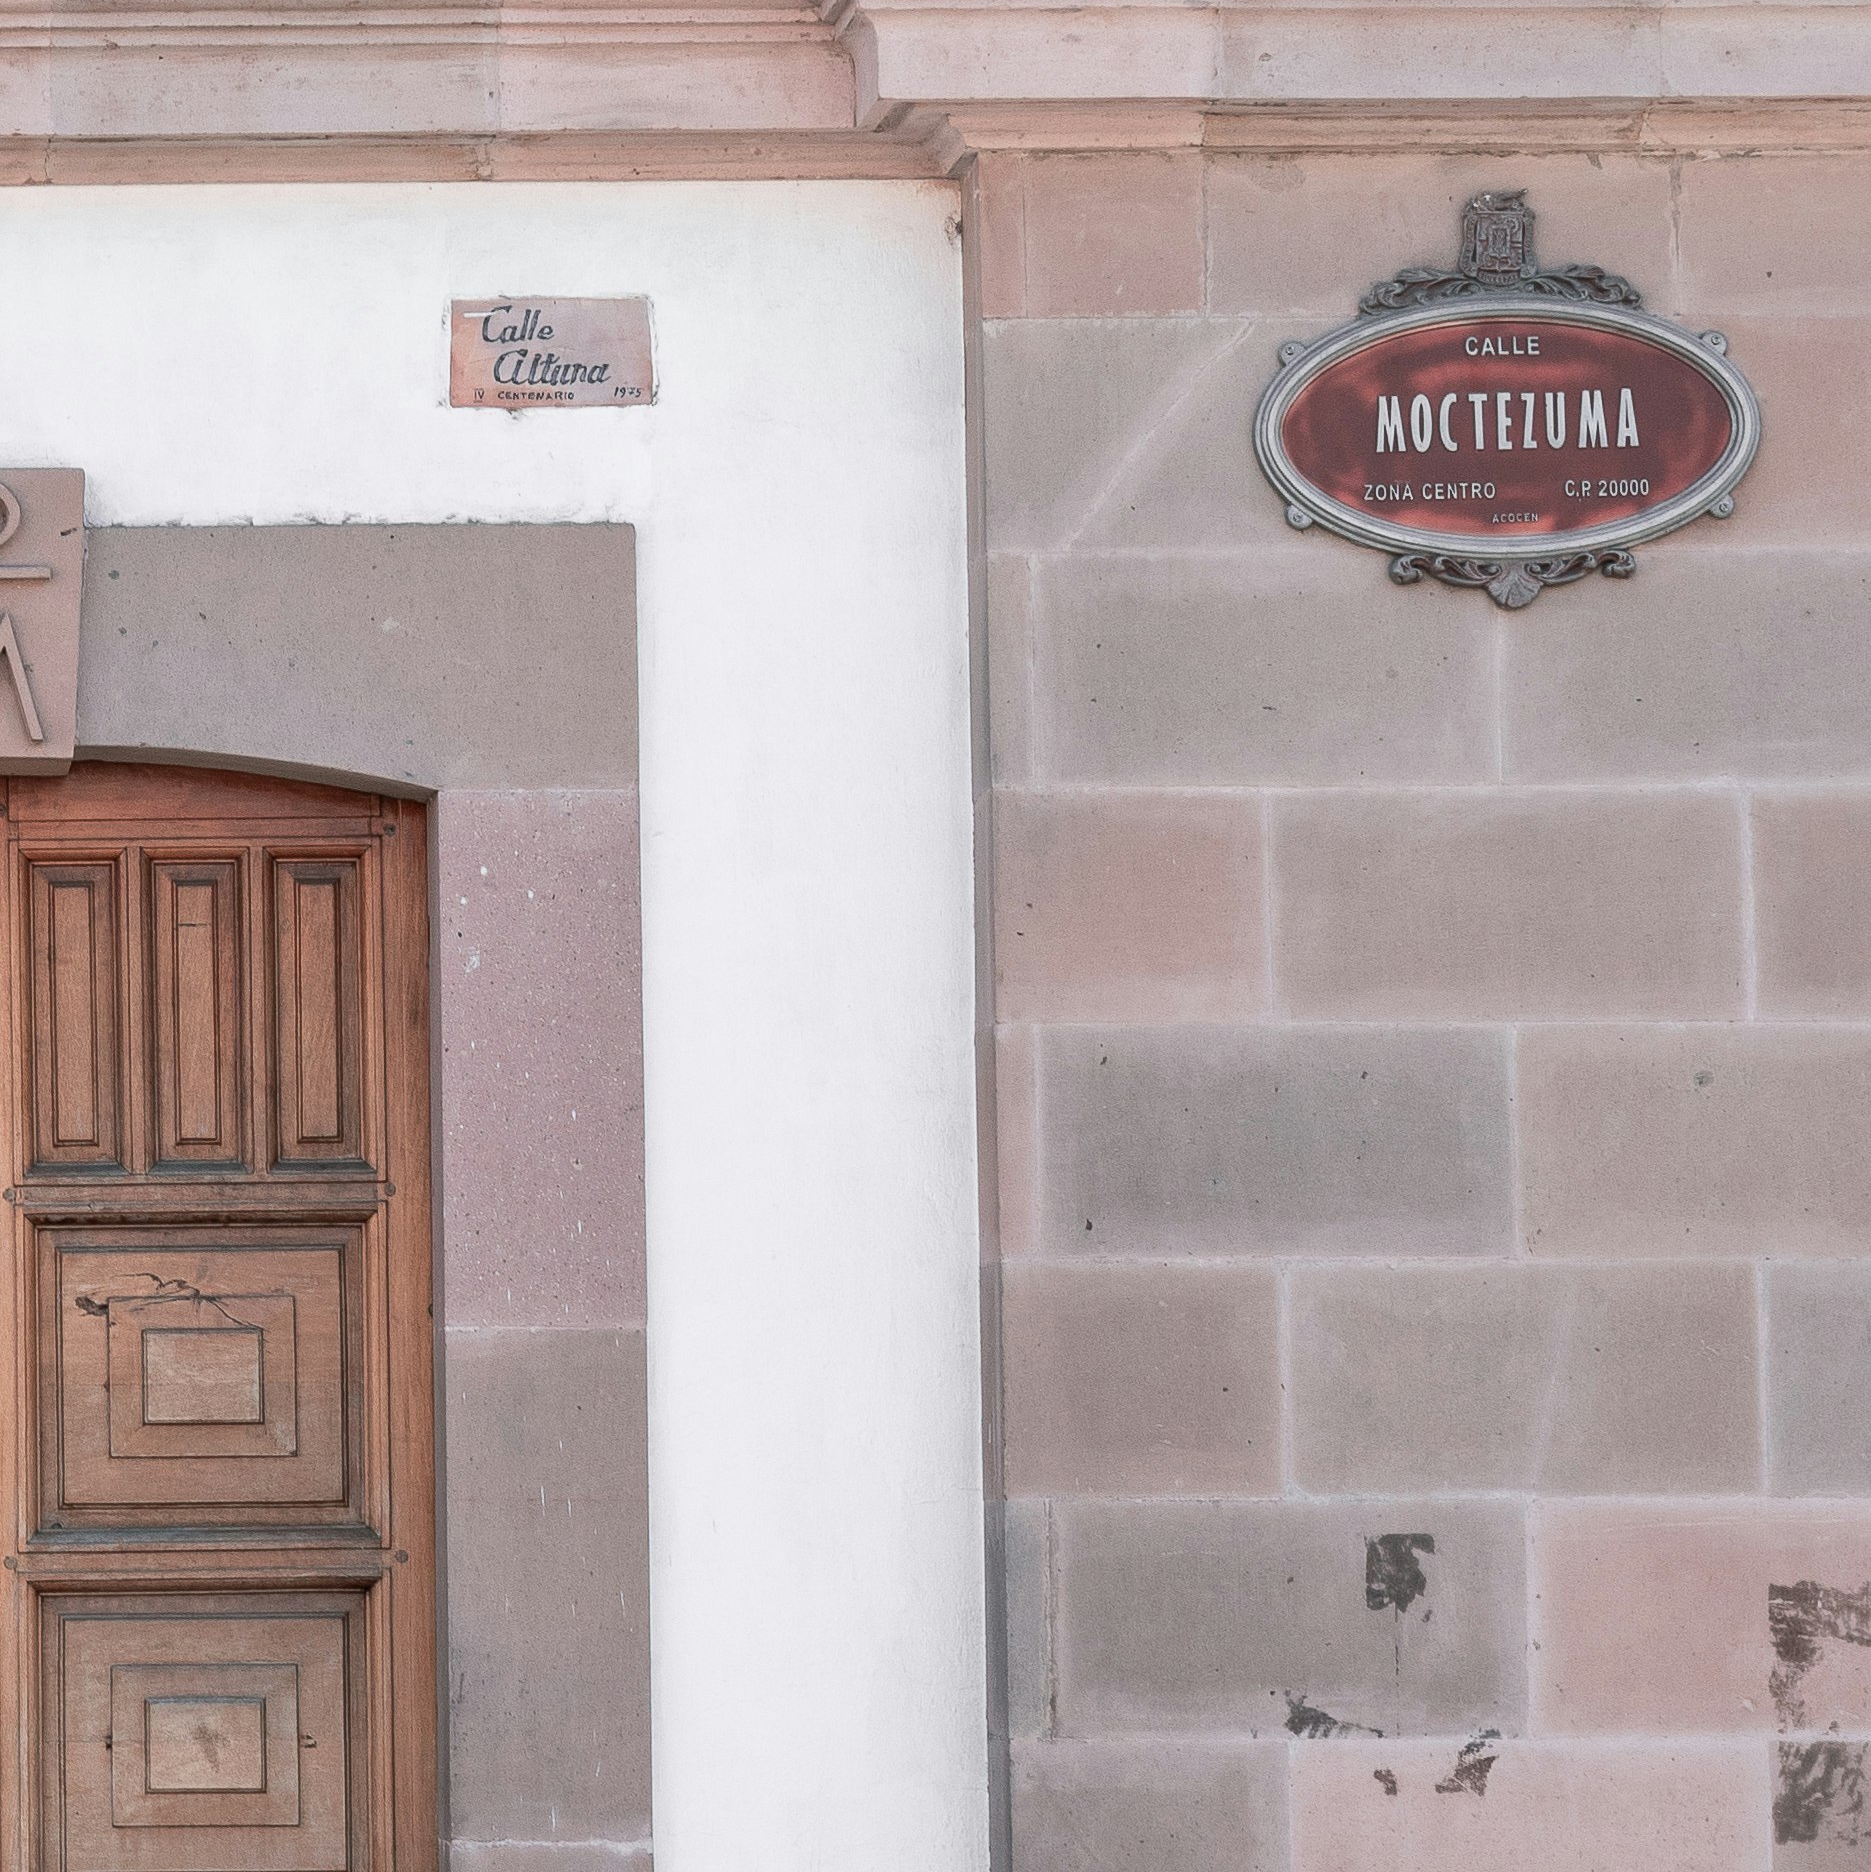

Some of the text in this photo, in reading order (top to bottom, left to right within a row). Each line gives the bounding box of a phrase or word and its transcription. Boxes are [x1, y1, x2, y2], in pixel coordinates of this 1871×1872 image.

[481, 305, 556, 344] Calle
[1464, 335, 1541, 357] CALLE
[492, 348, 612, 385] Altuna
[473, 386, 643, 403] IV CENTENARIO 1975
[1375, 387, 1641, 454] MOCTEZUMA
[1363, 481, 1497, 502] ZONA CENTRO
[1597, 478, 1650, 497] 20000
